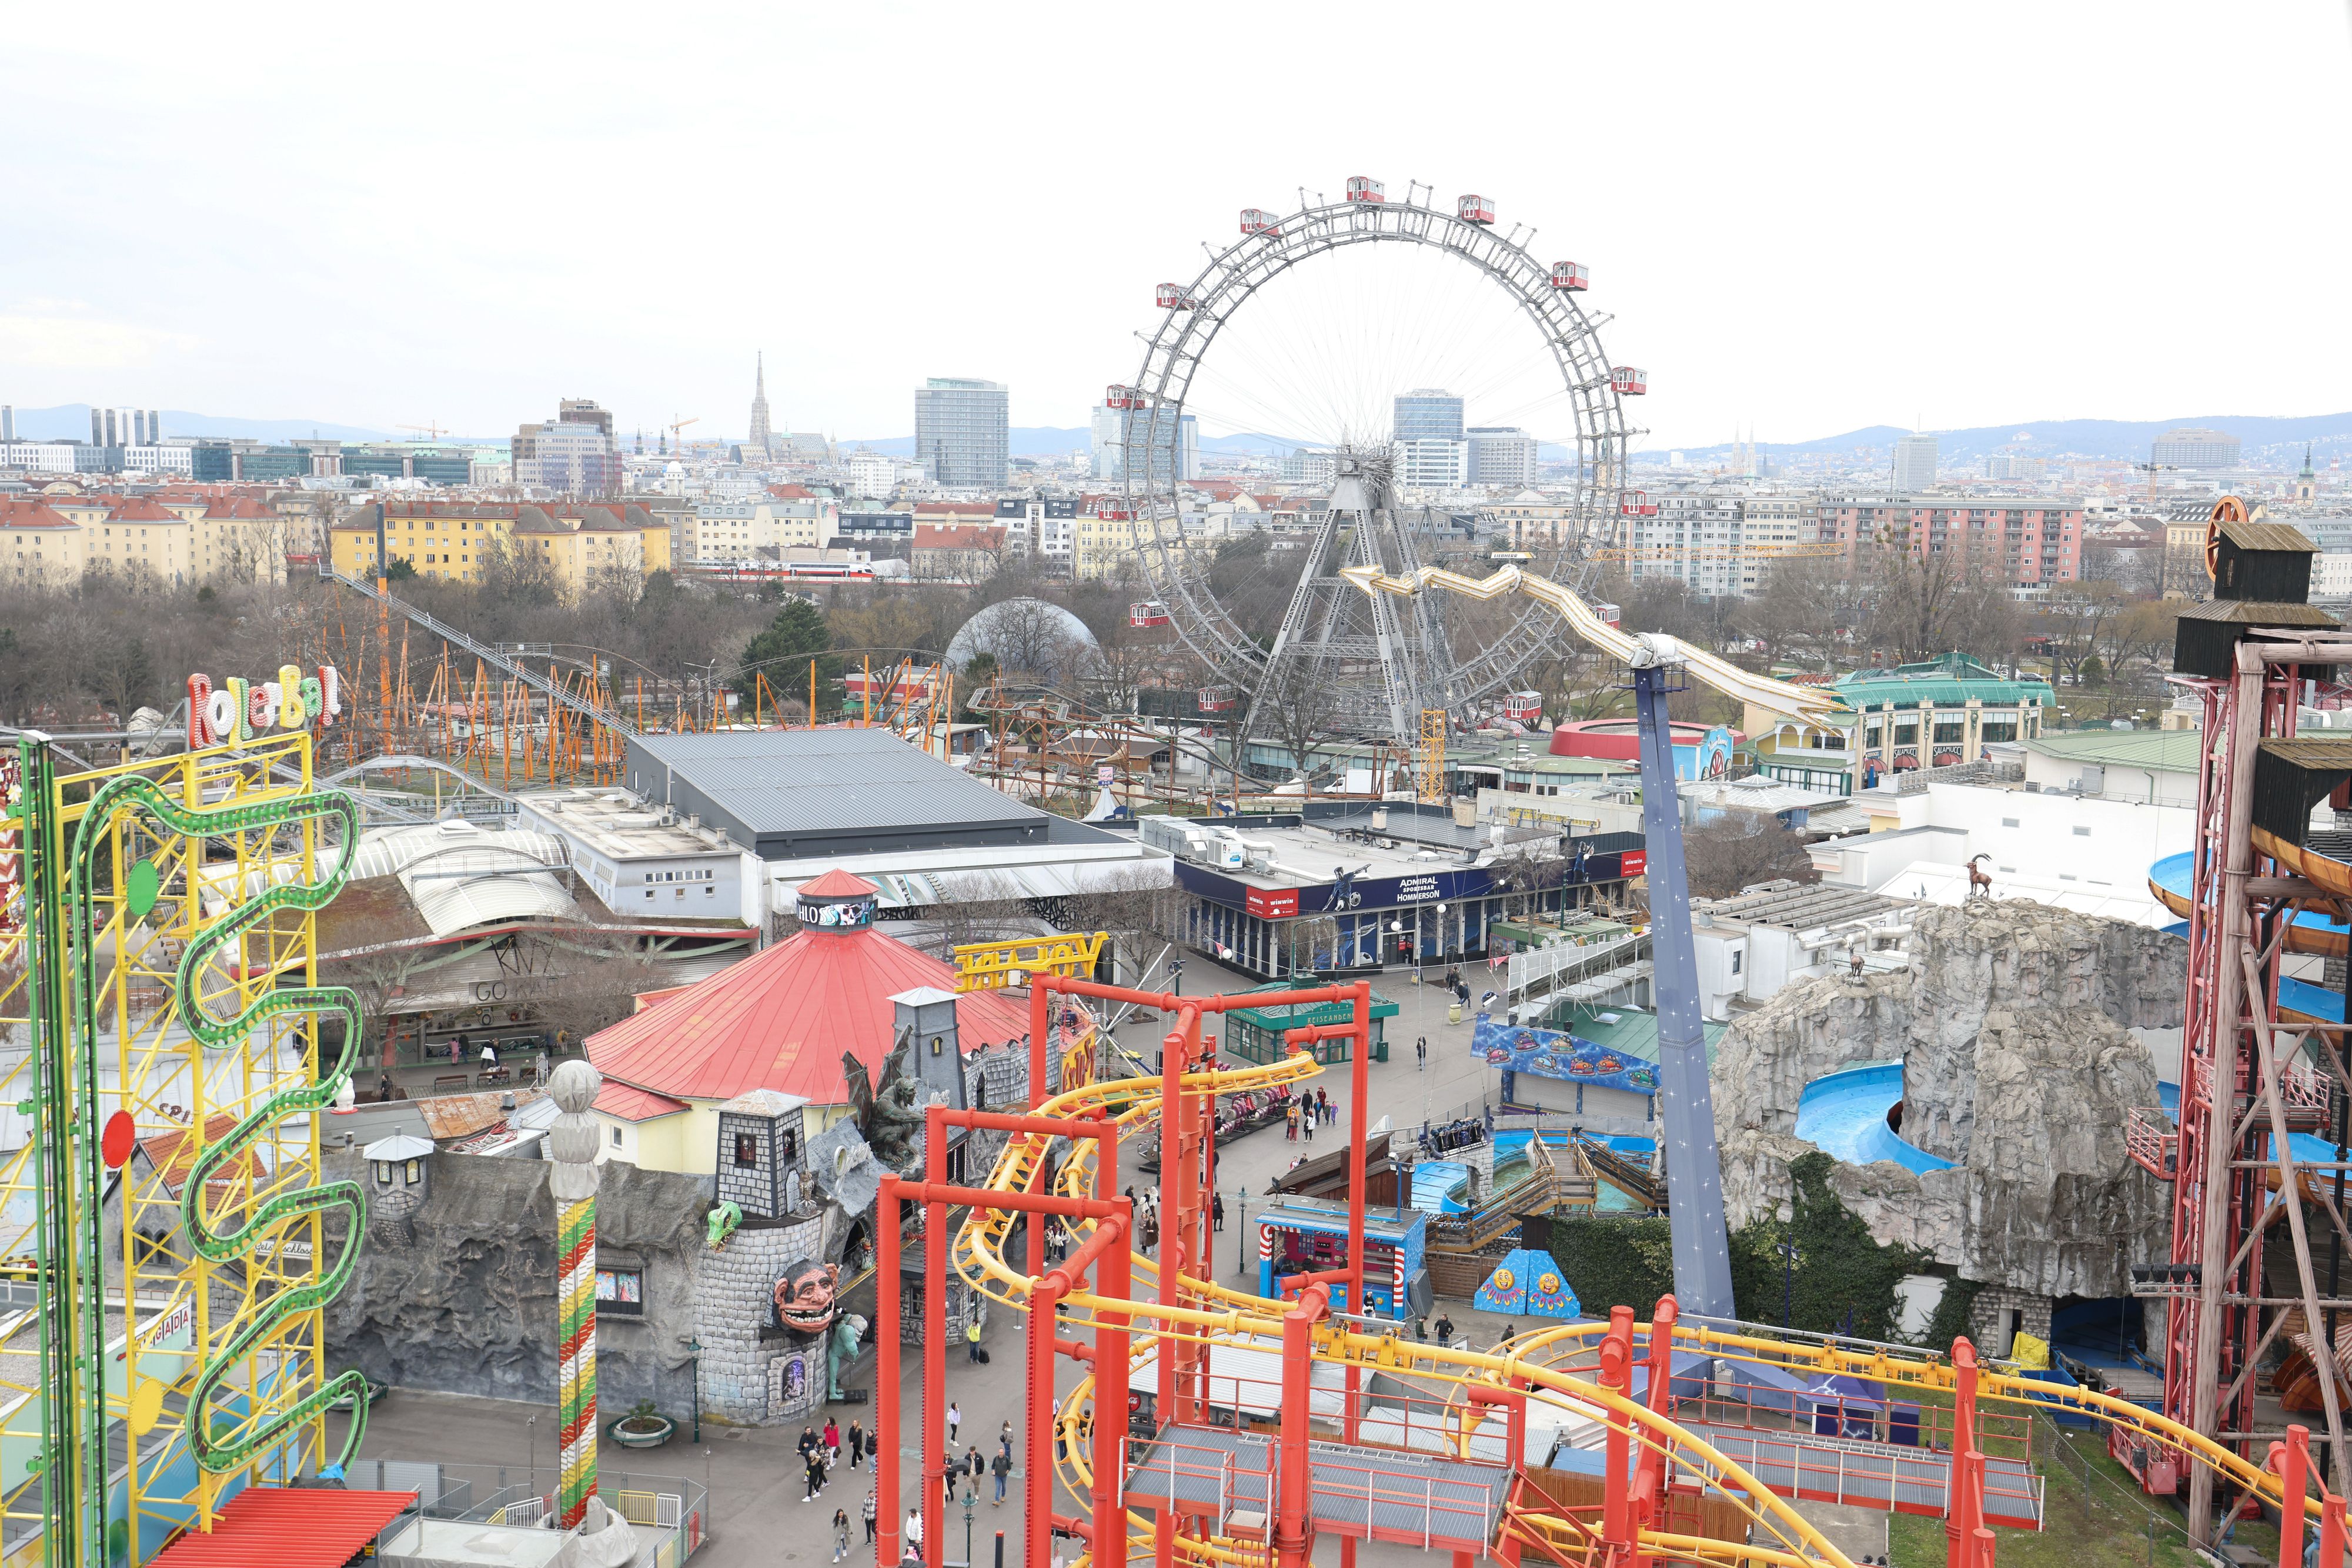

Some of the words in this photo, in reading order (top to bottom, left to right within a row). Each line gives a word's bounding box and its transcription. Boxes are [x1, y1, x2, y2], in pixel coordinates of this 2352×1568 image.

[1894, 748, 1917, 758] SALAMUCCI
[1933, 746, 1962, 757] SALAMUCCI
[1399, 876, 1438, 888] ADMIRAL
[1403, 885, 1435, 893] SPORTSBAR
[1397, 890, 1440, 902] HOMMERSON
[476, 982, 507, 1001] GO
[1481, 1283, 1526, 1306] SUUUPA
[1529, 1292, 1572, 1310] COOOL
